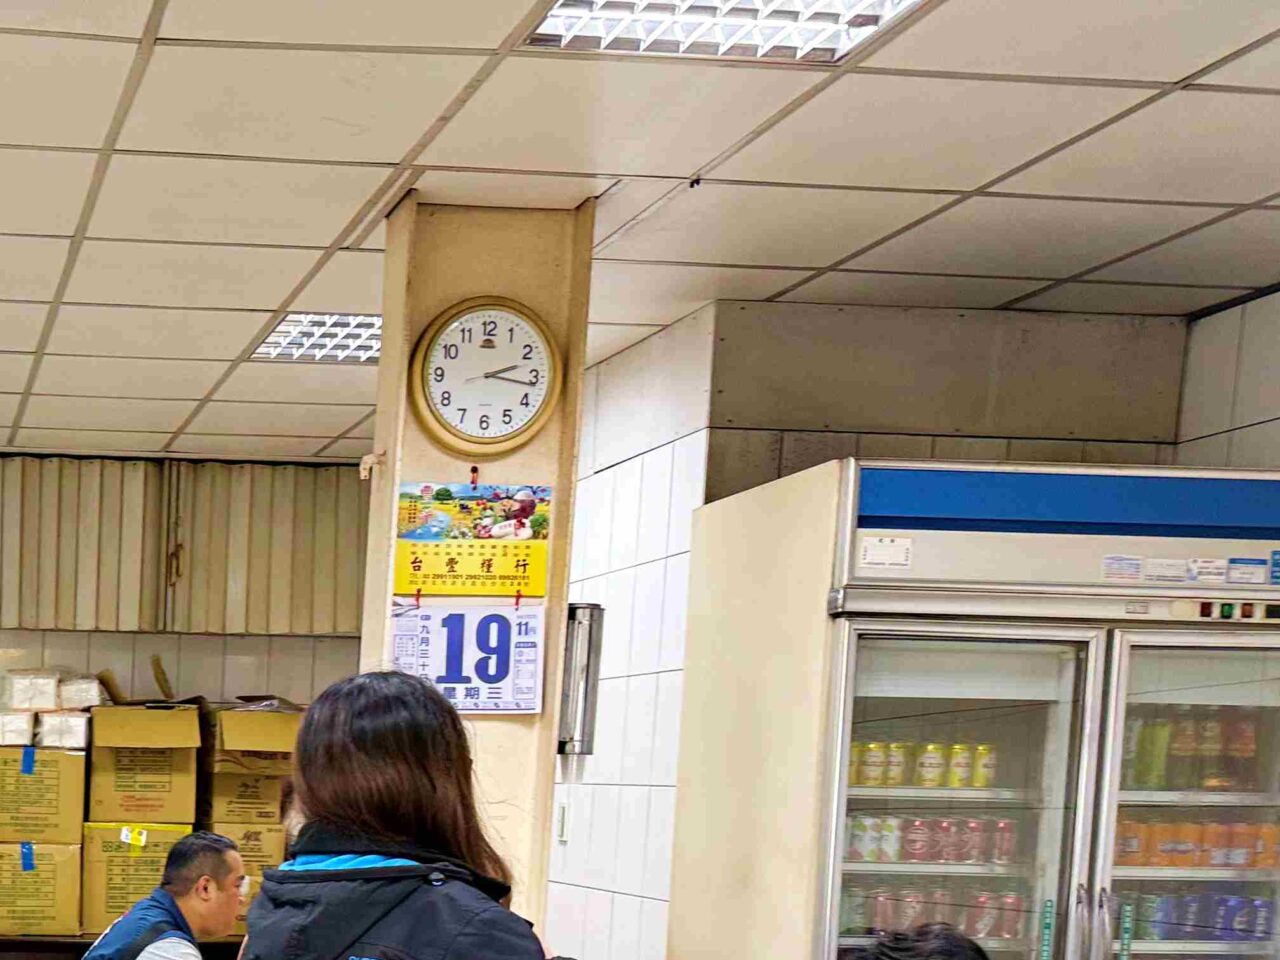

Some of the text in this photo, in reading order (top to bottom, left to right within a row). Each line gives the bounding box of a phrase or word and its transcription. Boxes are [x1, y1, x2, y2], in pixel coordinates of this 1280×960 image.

[460, 327, 473, 343] 11
[481, 320, 497, 337] 12
[507, 327, 515, 343] 1
[442, 343, 459, 360] 10
[522, 344, 533, 360] 2
[433, 366, 445, 382] 9
[528, 369, 540, 386] 3
[440, 390, 451, 406] 8
[519, 392, 530, 408] 4
[456, 408, 467, 424] 7
[479, 414, 490, 431] 6
[501, 409, 512, 425] 5
[435, 613, 512, 685] 19
[443, 686, 503, 700] 星期三
